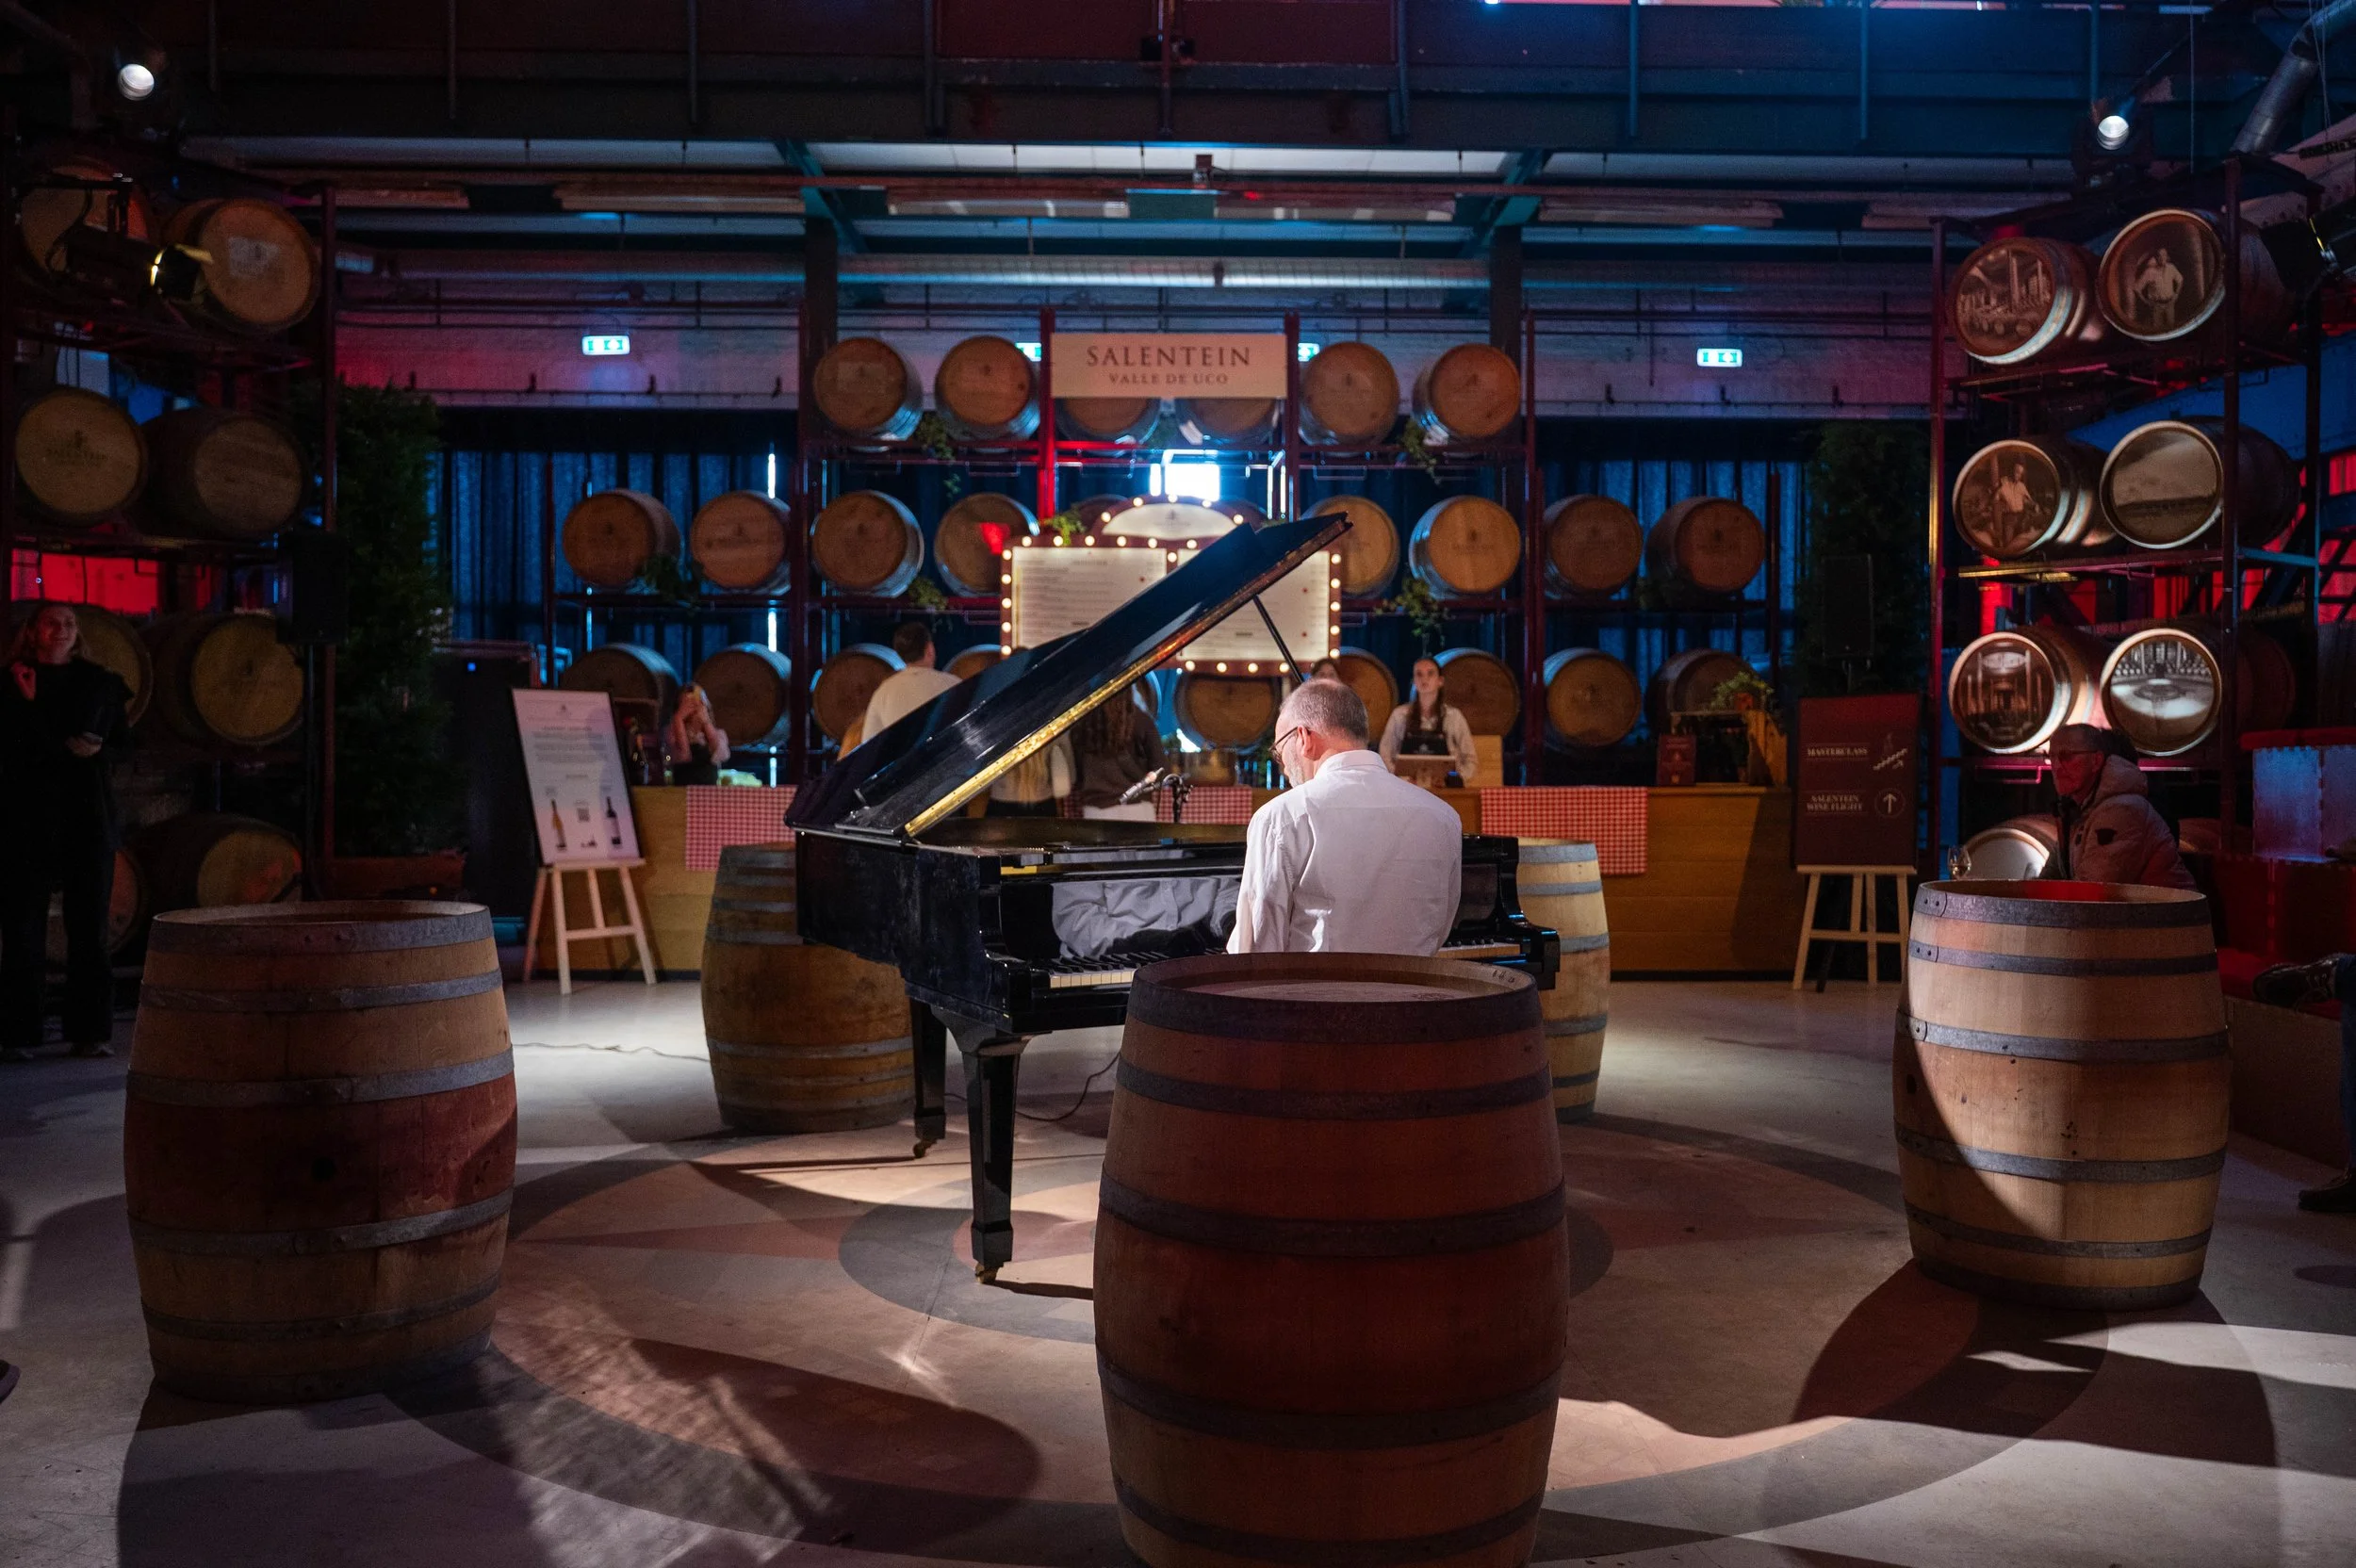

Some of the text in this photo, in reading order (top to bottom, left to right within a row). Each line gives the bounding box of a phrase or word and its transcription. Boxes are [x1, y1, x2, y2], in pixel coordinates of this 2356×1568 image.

[1086, 345, 1250, 367] SALENTEIN
[1108, 373, 1229, 385] VALLE DE UCO
[1807, 746, 1868, 757] MASTERCLASS
